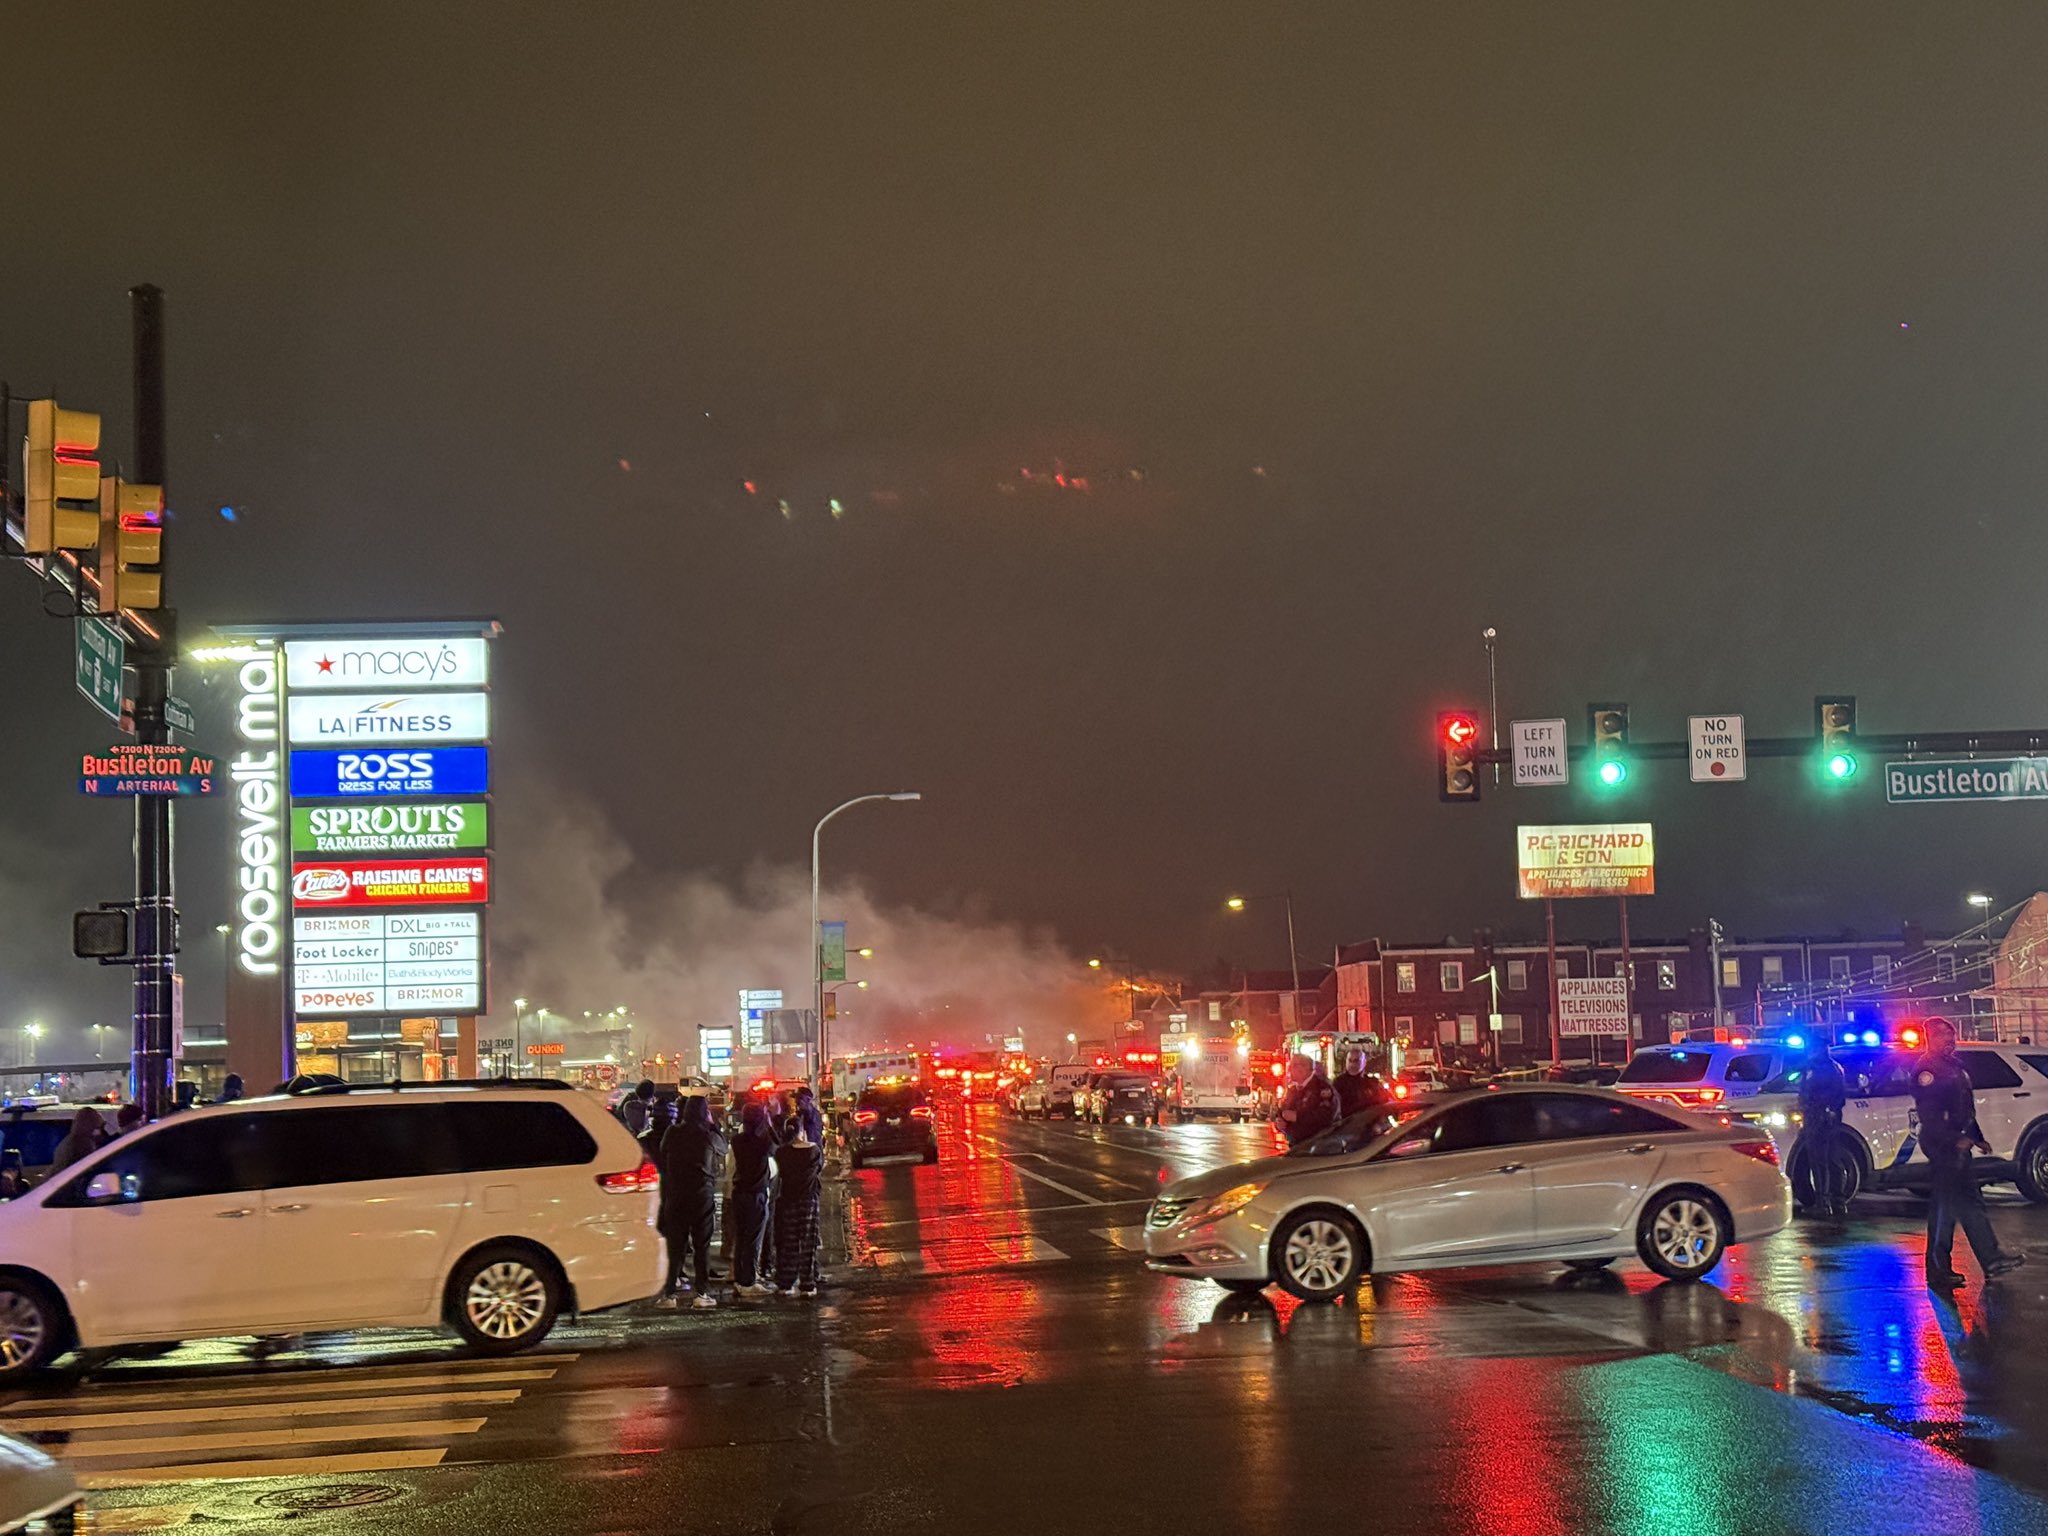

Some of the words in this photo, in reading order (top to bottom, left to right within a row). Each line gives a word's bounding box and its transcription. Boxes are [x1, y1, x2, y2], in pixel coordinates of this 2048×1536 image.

[343, 643, 457, 681] macy's
[319, 718, 345, 734] LA
[356, 715, 452, 733] FITNESS
[1705, 719, 1727, 732] NO
[1523, 728, 1552, 742] LEFT
[1702, 733, 1733, 746] TURN
[120, 746, 142, 754] 7300
[144, 745, 153, 754] N
[155, 746, 177, 754] 7200
[1524, 745, 1556, 759] TURN
[1695, 747, 1713, 760] ON
[1715, 746, 1739, 758] RED
[83, 755, 182, 775] Bustleton
[190, 757, 213, 774] Av
[337, 752, 433, 779] ROSS
[1519, 763, 1563, 778] SIGNAL
[86, 780, 98, 793] N
[116, 780, 179, 792] ARTERIAL
[200, 779, 211, 793] S
[338, 781, 375, 792] DRESS
[378, 780, 401, 791] FOR
[405, 780, 433, 790] LESS
[1891, 768, 2014, 796] Bustleton
[309, 806, 465, 836] SPROUTS
[317, 836, 388, 850] FARMERS
[390, 834, 458, 849] MARKET
[233, 751, 278, 974] roosevelt
[1557, 851, 1569, 864] &
[1573, 850, 1614, 864] SON
[351, 870, 421, 885] RAISING
[424, 868, 483, 884] CANE'S
[366, 885, 417, 896] CHICKEN
[419, 883, 470, 895] FINGERS
[304, 920, 370, 931] BRIXMOR
[391, 919, 426, 933] DXL
[296, 947, 327, 959] Foot
[332, 946, 379, 958] Locker
[409, 941, 453, 958] snipes
[397, 988, 463, 1000] BRIXMOR
[1560, 981, 1625, 995] APPLIANCES
[1561, 999, 1626, 1013] TELEVISIONS
[1562, 1018, 1627, 1033] MATTRESSES
[527, 1045, 564, 1054] DUNKIN
[1204, 1055, 1229, 1063] WATER
